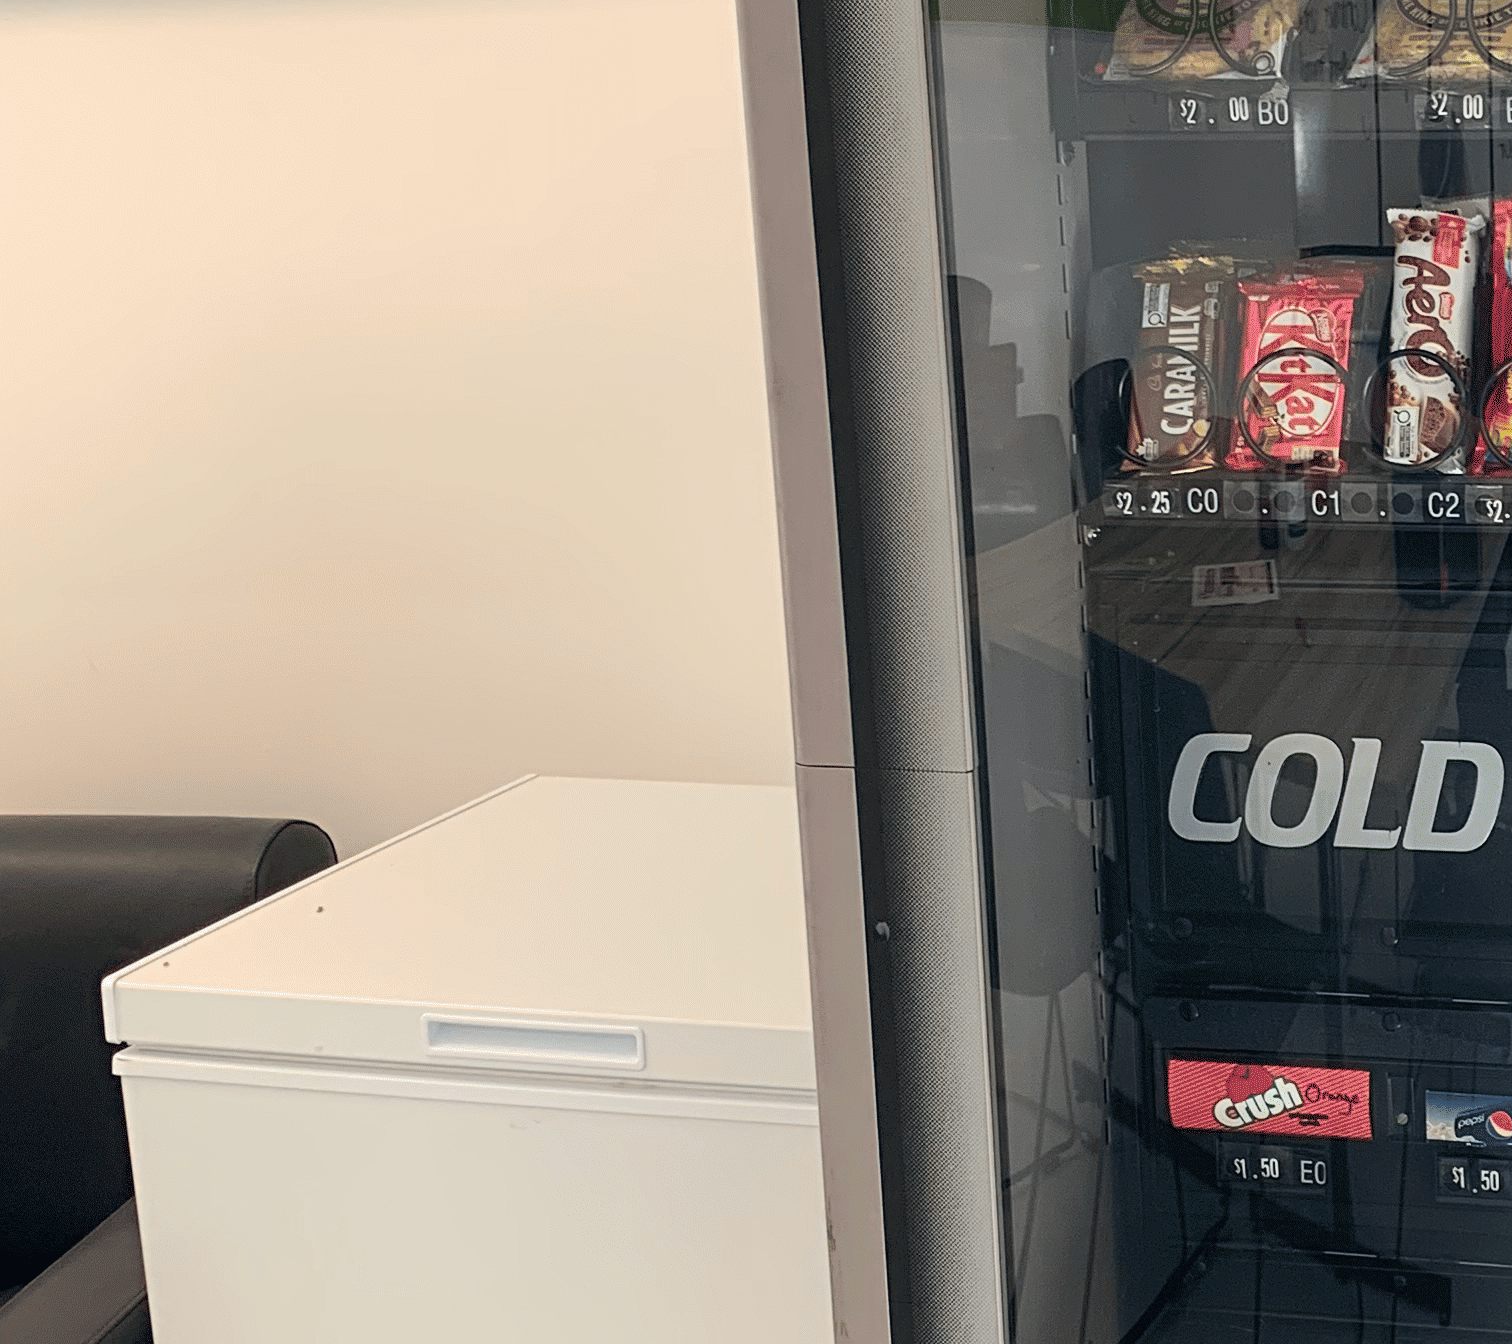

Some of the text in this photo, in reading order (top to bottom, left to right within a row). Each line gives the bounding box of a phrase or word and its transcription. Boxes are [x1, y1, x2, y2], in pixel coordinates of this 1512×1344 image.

[1258, 101, 1289, 126] B0
[1397, 256, 1455, 379] Aero
[1160, 303, 1202, 436] CARAMILK
[1256, 323, 1338, 432] KtKat
[1187, 488, 1219, 514] C0
[1311, 490, 1341, 516] C1
[1428, 493, 1461, 519] C2
[1167, 731, 1506, 853] COLD
[1214, 1076, 1303, 1128] Crush
[1305, 1083, 1360, 1116] Orange
[1457, 1112, 1485, 1130] pepsi
[1234, 1158, 1327, 1185] $1.50 E0
[1452, 1167, 1500, 1194] $1.50
